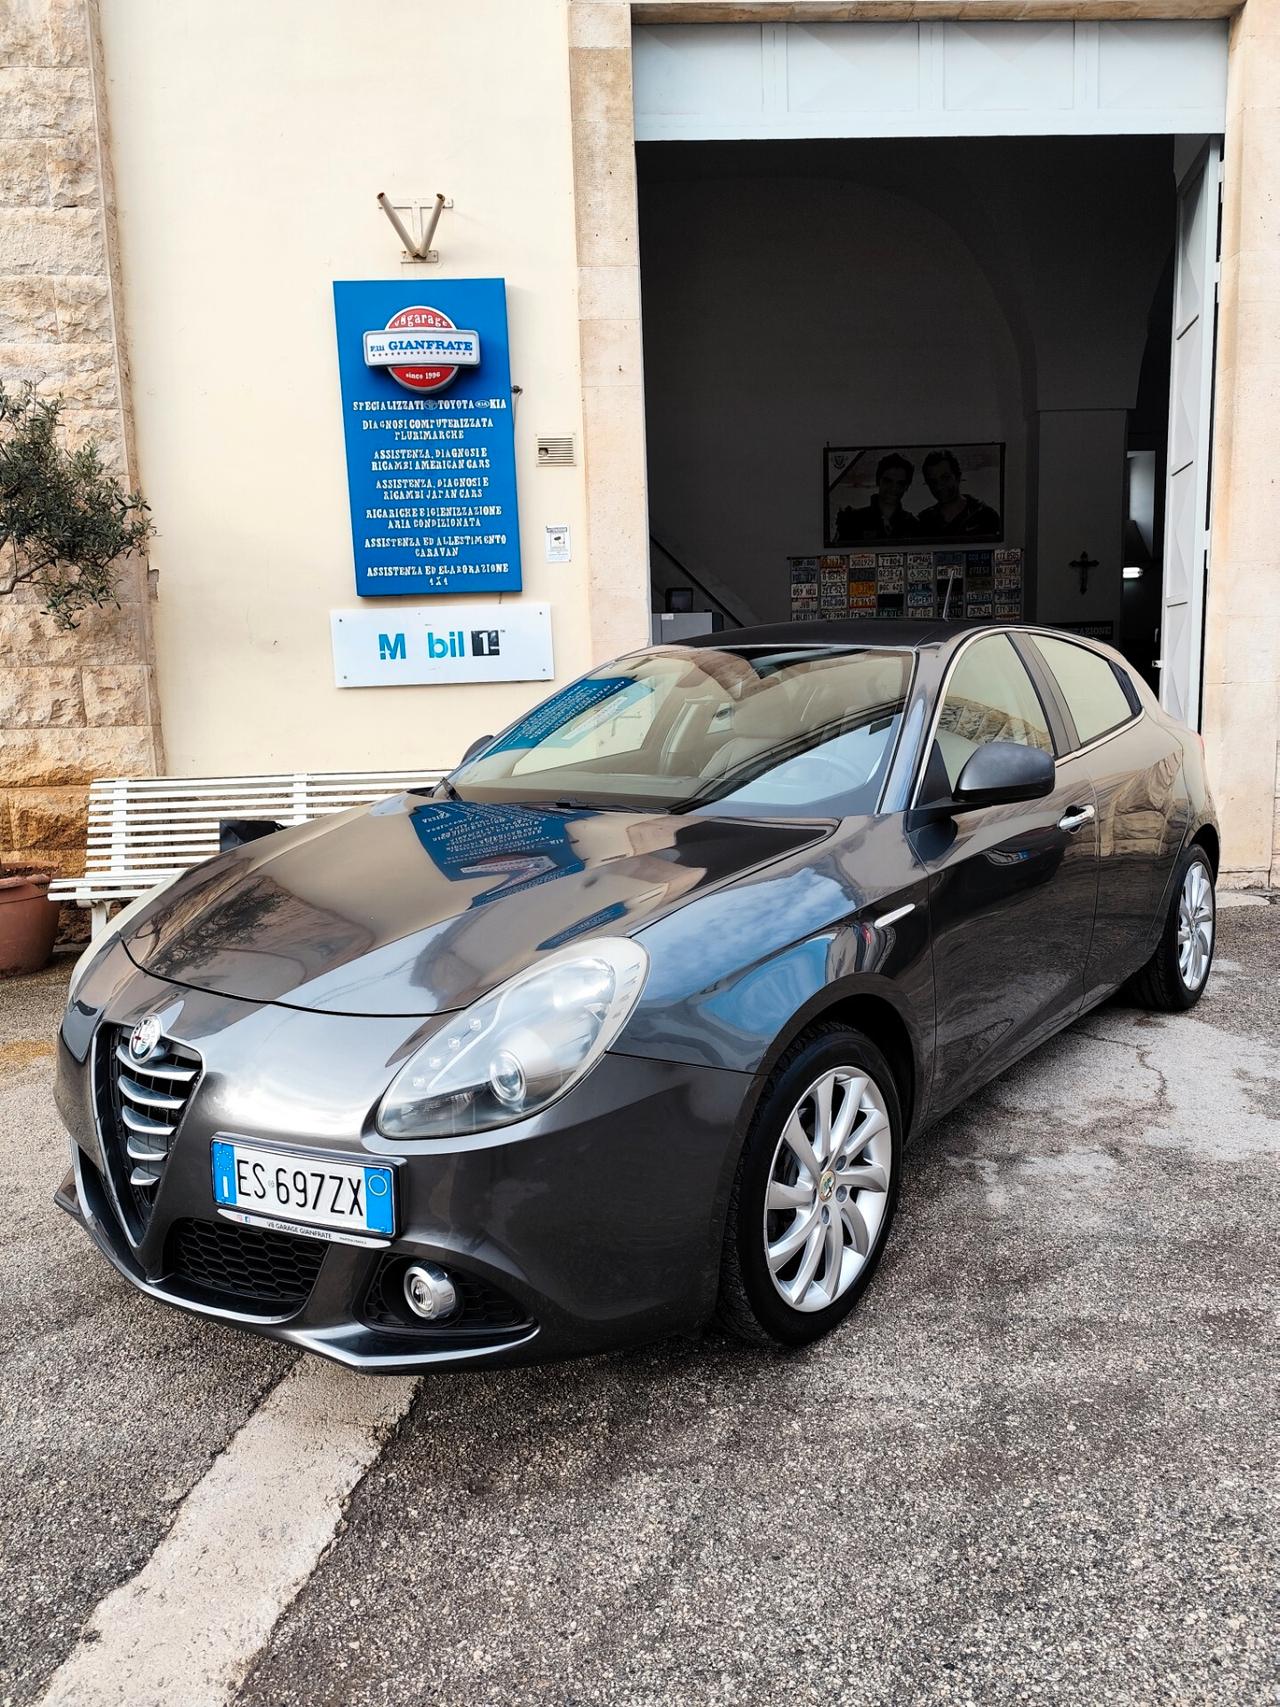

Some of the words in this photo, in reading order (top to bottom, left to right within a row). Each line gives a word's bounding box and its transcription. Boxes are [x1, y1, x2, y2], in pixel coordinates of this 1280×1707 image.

[388, 340, 473, 351] GIANFRATE
[406, 372, 424, 380] since
[354, 401, 424, 410] SPECIALIZZATI
[438, 400, 474, 409] TOYOTA
[490, 399, 506, 408] KIA
[363, 420, 407, 429] DIAGNOSI
[410, 418, 493, 429] COMPUTERIZZATA
[395, 430, 463, 440] PLURIMARCHE
[436, 448, 479, 457] DIAGNOSI
[481, 448, 487, 457] E
[372, 461, 412, 470] RICAMBI
[415, 460, 464, 469] AMERICAN
[467, 459, 489, 468] CARS
[438, 478, 480, 487] DIAGNOSI
[483, 477, 488, 486] E
[384, 490, 423, 499] RICAMBI
[427, 489, 457, 499] JAPAN
[460, 489, 482, 498] CARS
[367, 508, 417, 518] RICARICHE
[419, 508, 425, 517] E
[427, 506, 501, 516] IGIENIZZAZIONE
[388, 520, 410, 528] ARIA
[414, 518, 480, 528] CONDIZIONATA
[365, 538, 420, 547] ASSISTENZA
[423, 537, 433, 546] ED
[437, 535, 506, 545] ALLESTIMENTO
[416, 547, 458, 557] CARAVAN
[367, 567, 422, 576] ASSISTENZA
[425, 566, 436, 575] ED
[439, 564, 508, 574] ELABORAZIONE
[237, 1159, 266, 1199] ES
[275, 1167, 364, 1217] 697ZX
[275, 1222, 299, 1233] GARAGE
[299, 1226, 332, 1240] GIANFRATE
